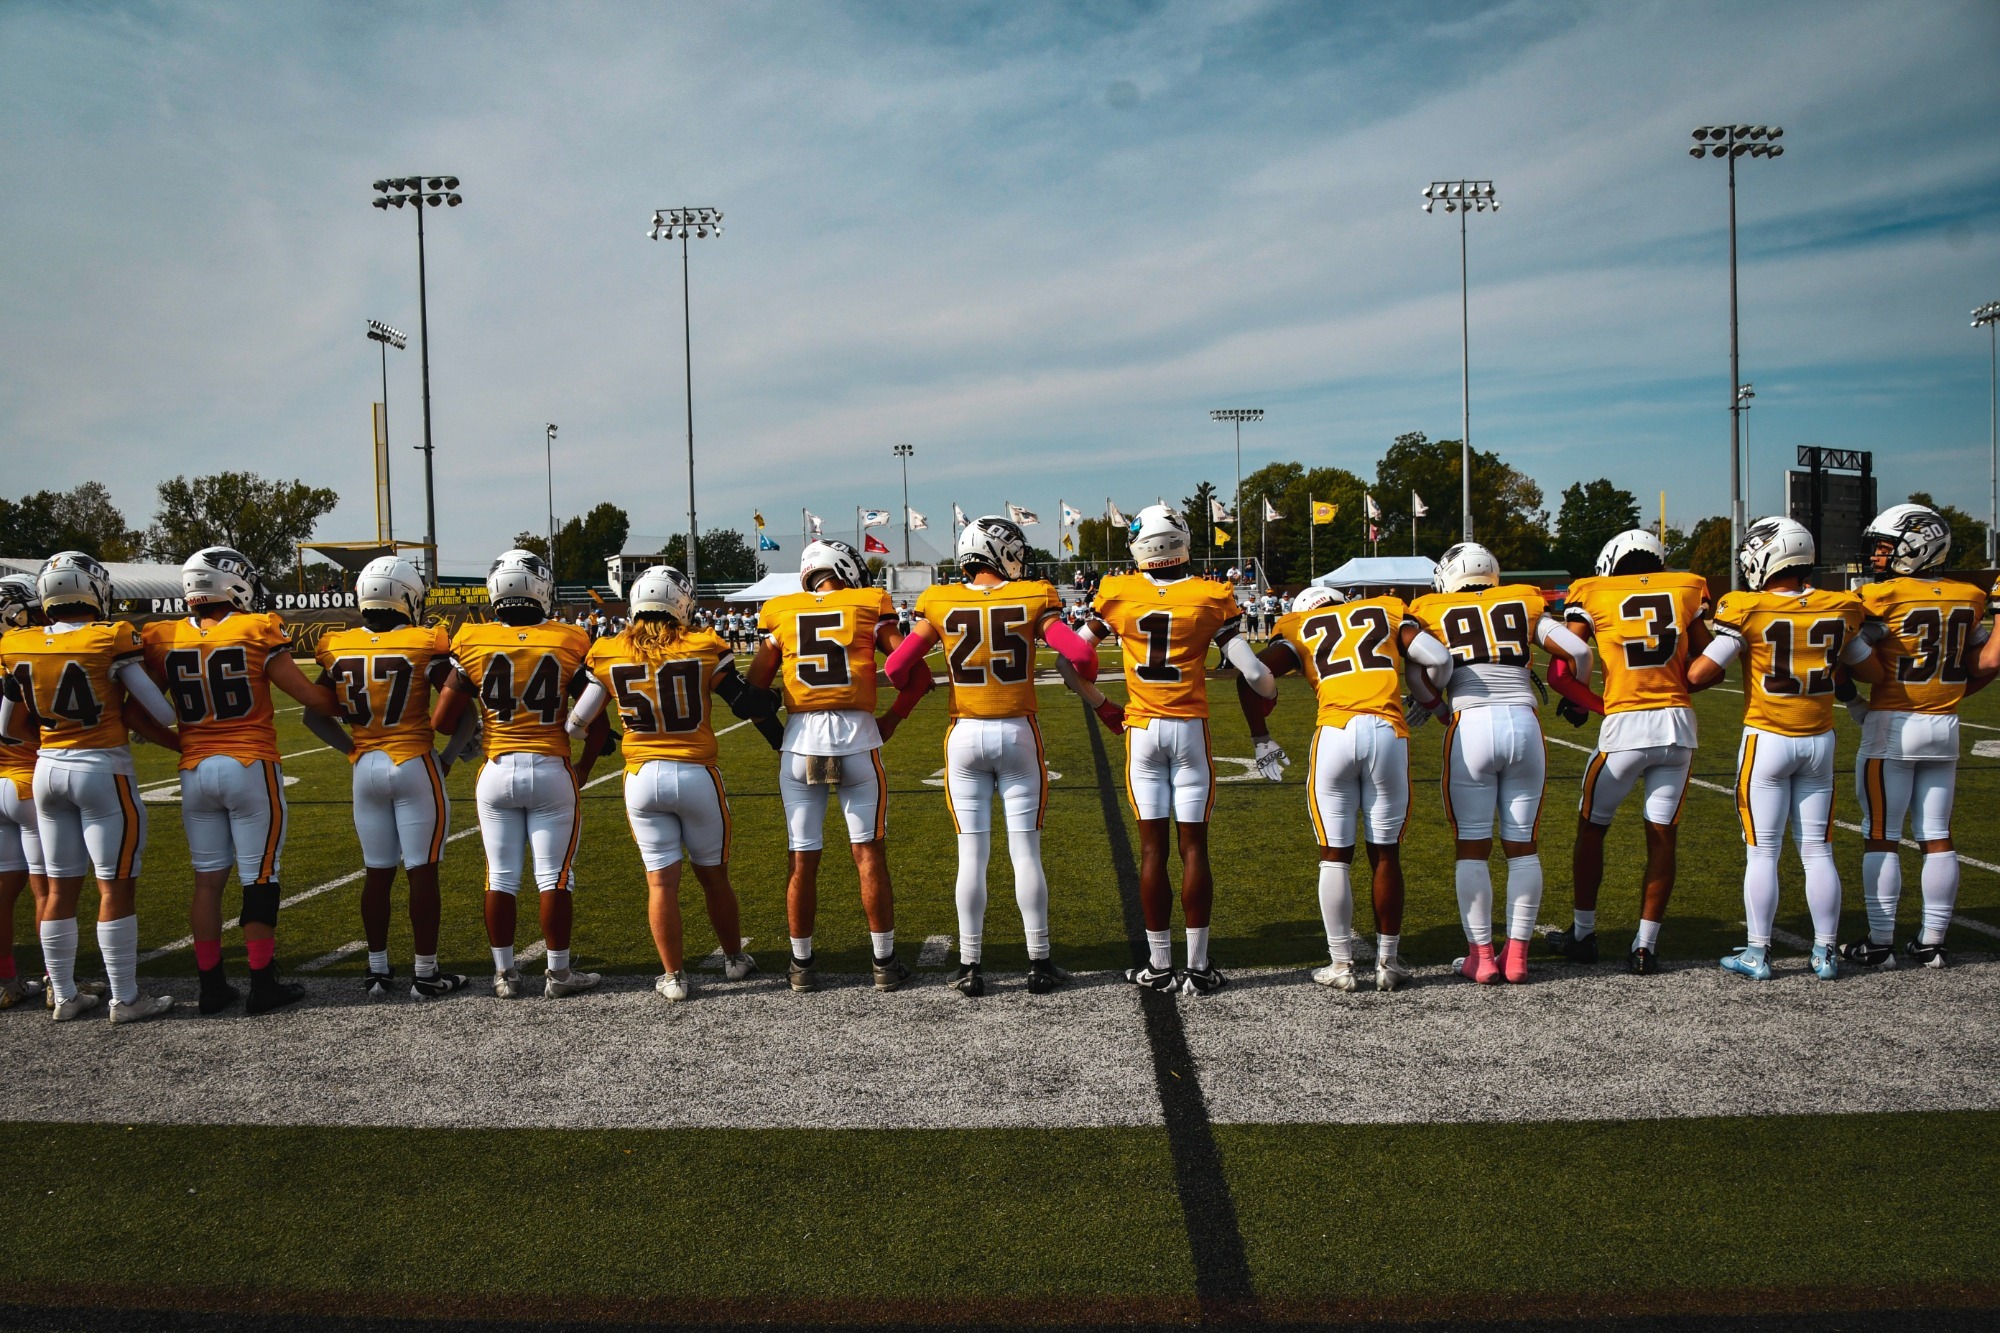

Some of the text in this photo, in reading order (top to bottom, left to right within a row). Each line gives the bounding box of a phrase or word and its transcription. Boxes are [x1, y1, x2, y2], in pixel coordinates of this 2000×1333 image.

[1148, 558, 1180, 568] Riddell
[1921, 523, 1944, 540] 30
[152, 592, 355, 613] PAR SPONSOR
[1440, 600, 1531, 668] 99
[1619, 592, 1680, 670] 3
[796, 611, 852, 689] 5
[944, 604, 1028, 686] 25
[1135, 610, 1182, 683] 1
[1301, 606, 1394, 683] 22
[1761, 618, 1846, 696] 13
[1896, 606, 1975, 684] 30
[12, 660, 104, 730] 14
[165, 646, 253, 724] 66
[330, 655, 415, 729] 37
[480, 651, 563, 726] 44
[609, 658, 704, 735] 50
